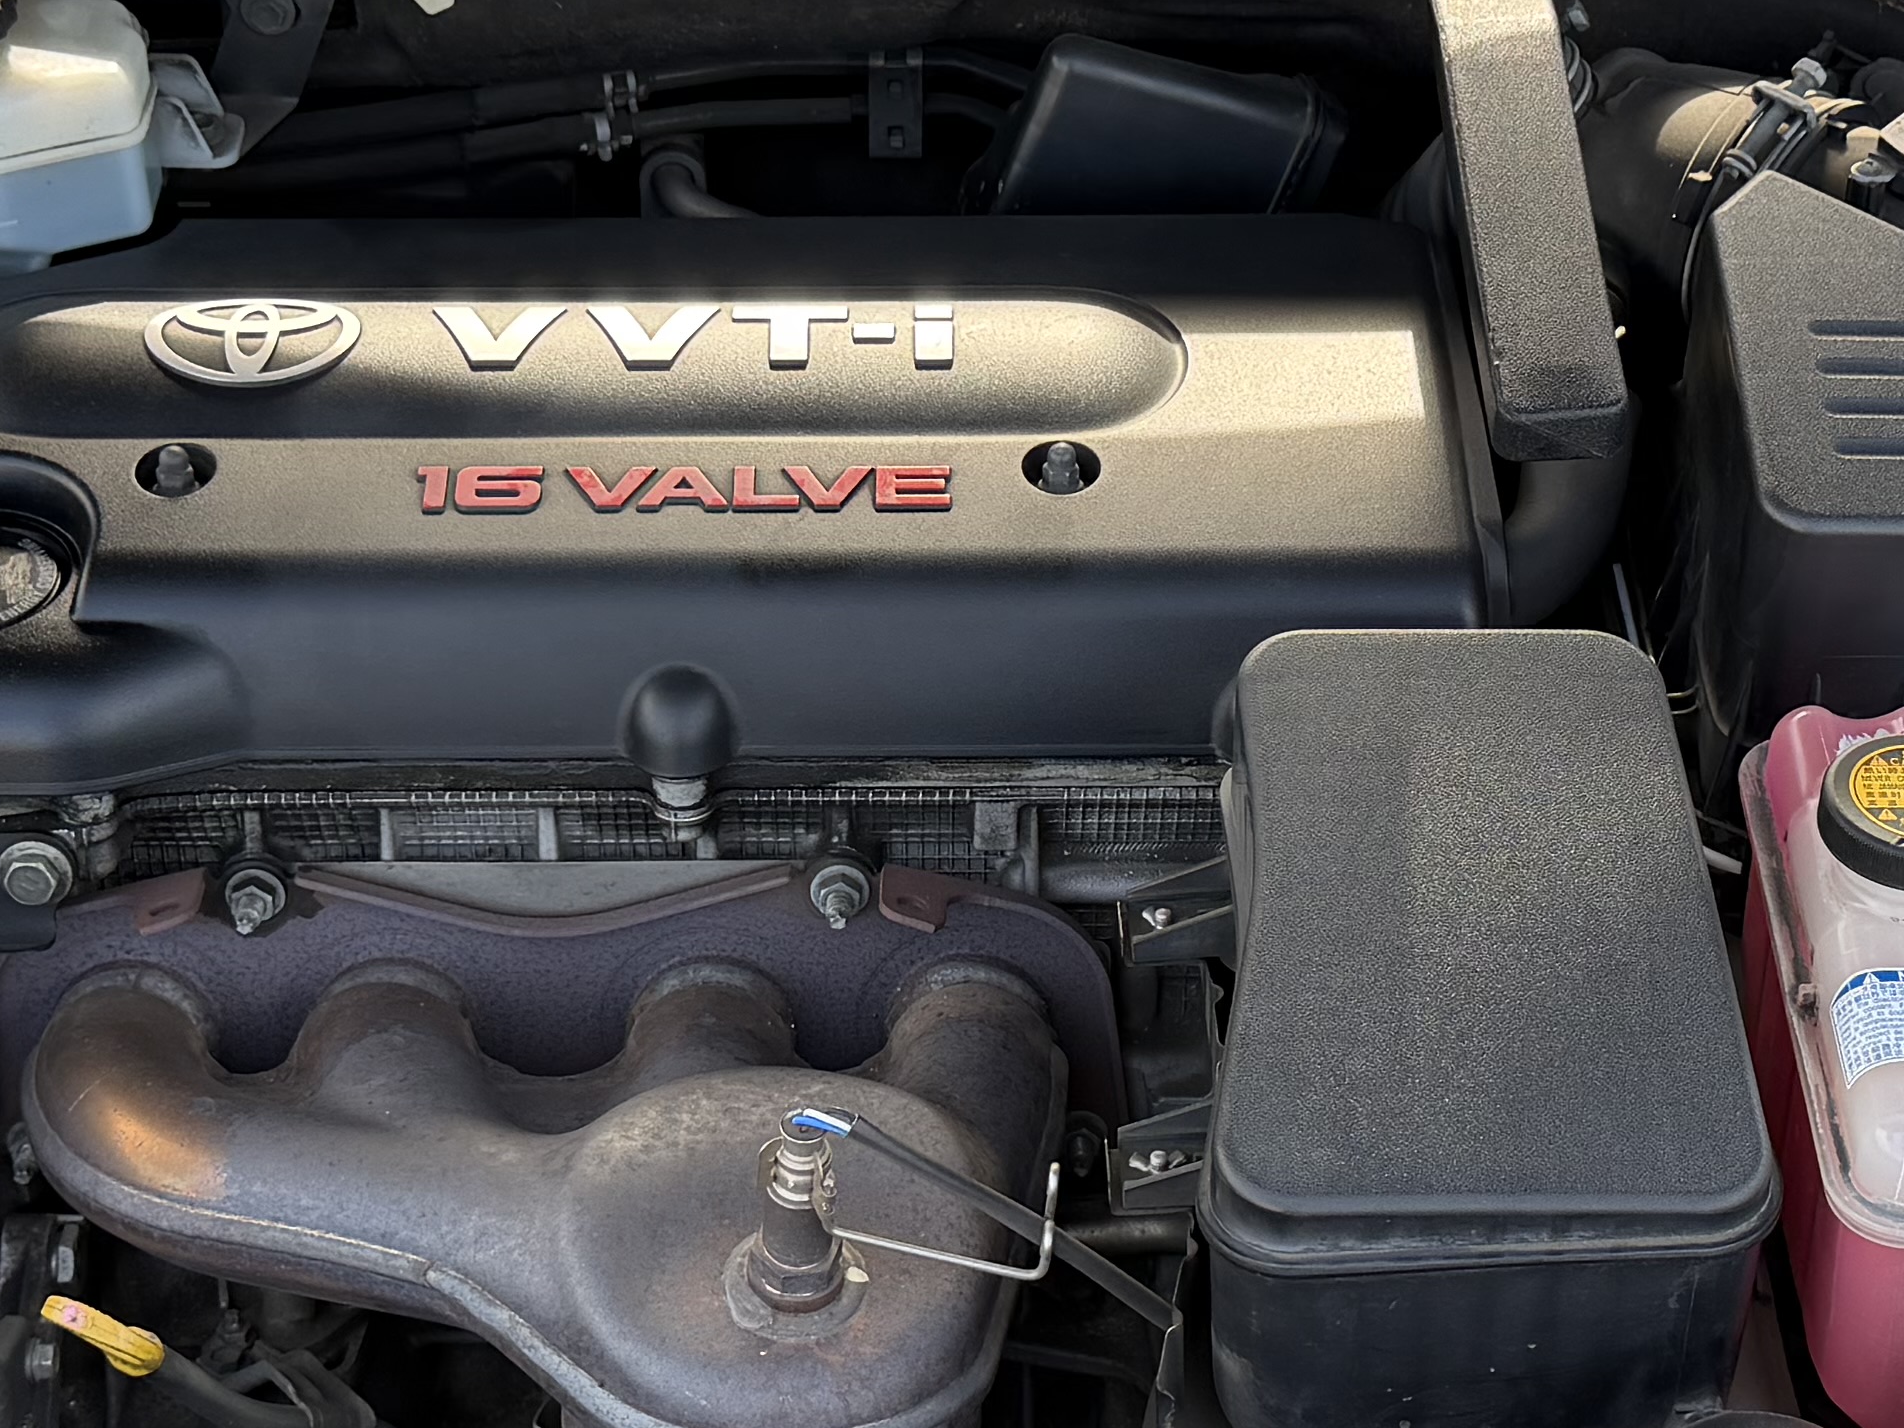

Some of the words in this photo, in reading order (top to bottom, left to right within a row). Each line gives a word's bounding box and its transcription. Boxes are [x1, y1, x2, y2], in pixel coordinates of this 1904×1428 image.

[432, 304, 955, 372] VVT-i
[416, 465, 545, 515] 16
[564, 465, 954, 515] VALVE
